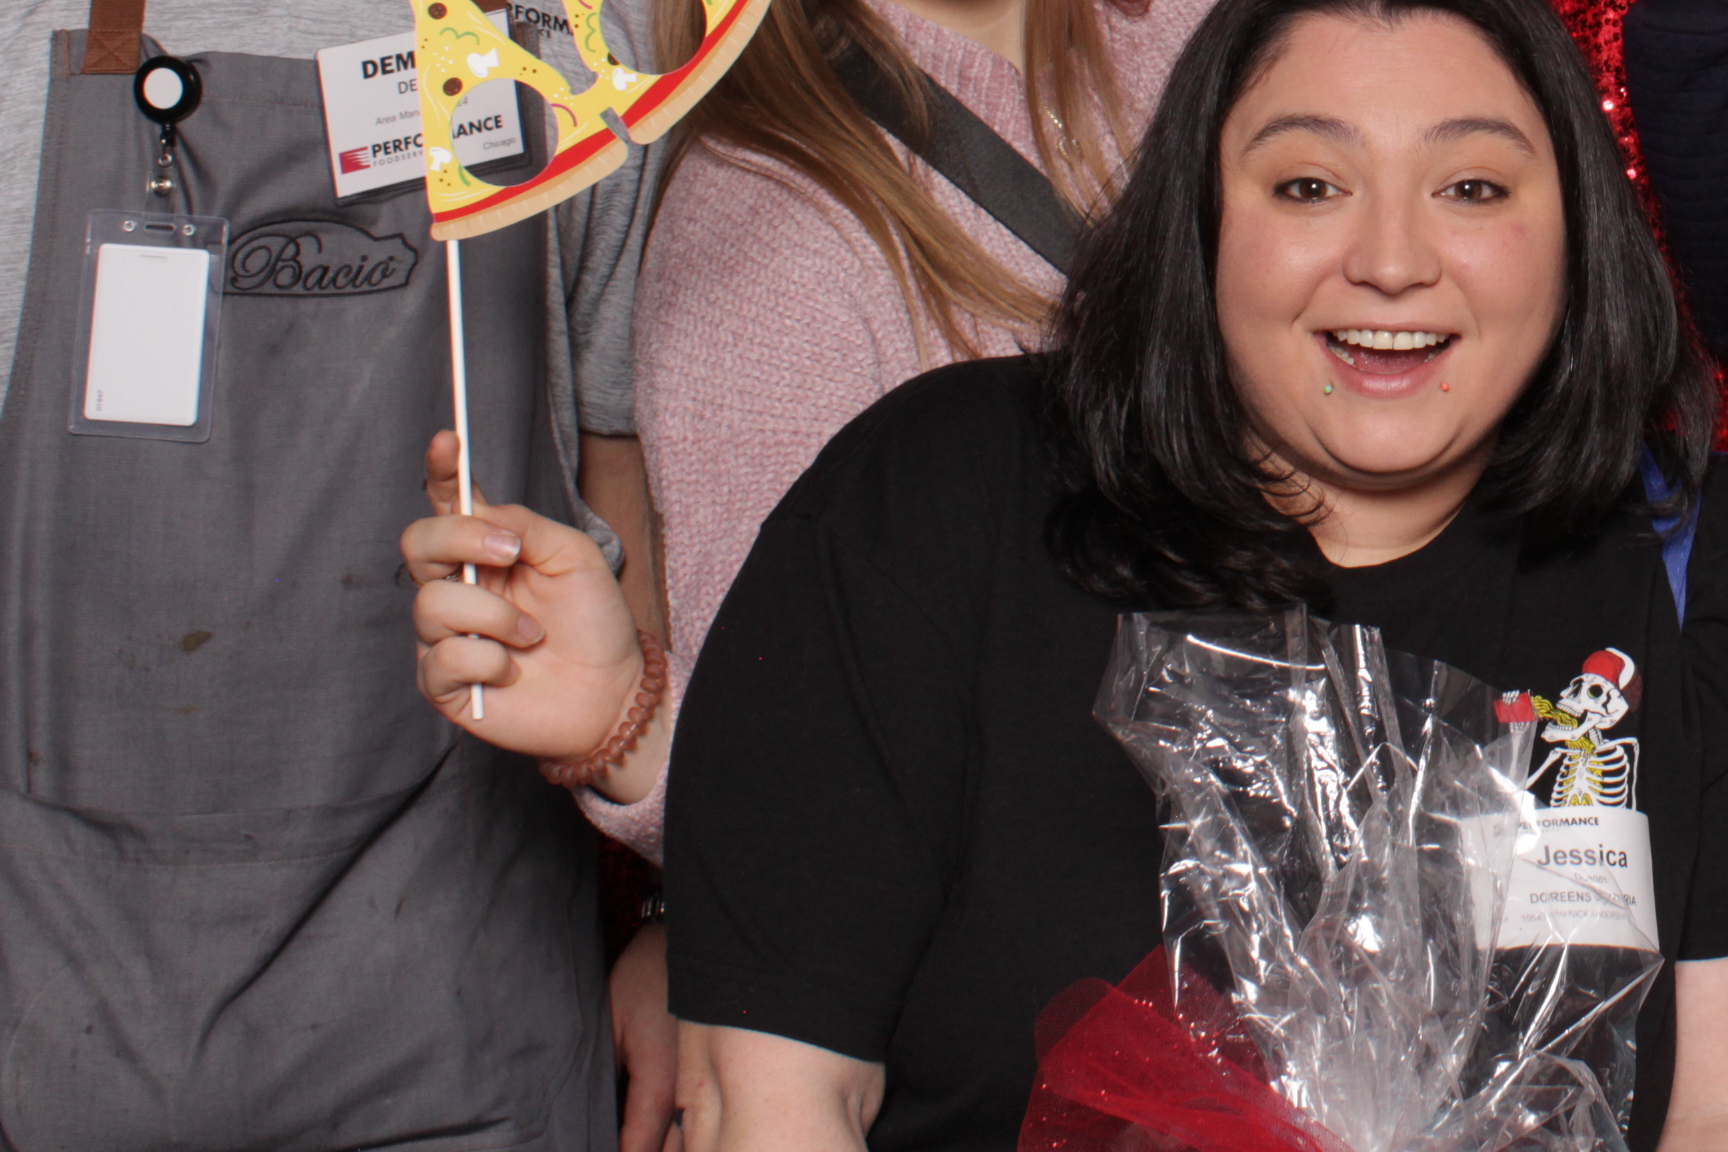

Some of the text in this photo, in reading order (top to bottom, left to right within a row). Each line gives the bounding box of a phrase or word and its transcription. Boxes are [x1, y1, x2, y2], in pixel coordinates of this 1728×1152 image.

[505, 2, 573, 36] FORM
[362, 51, 416, 79] DEM
[398, 79, 418, 94] DE
[483, 137, 517, 150] Chicago
[231, 232, 397, 290] Bacio
[1518, 817, 1600, 831] PEFORMANCE
[1537, 844, 1628, 869] Jessica
[1529, 891, 1592, 905] DOREENS
